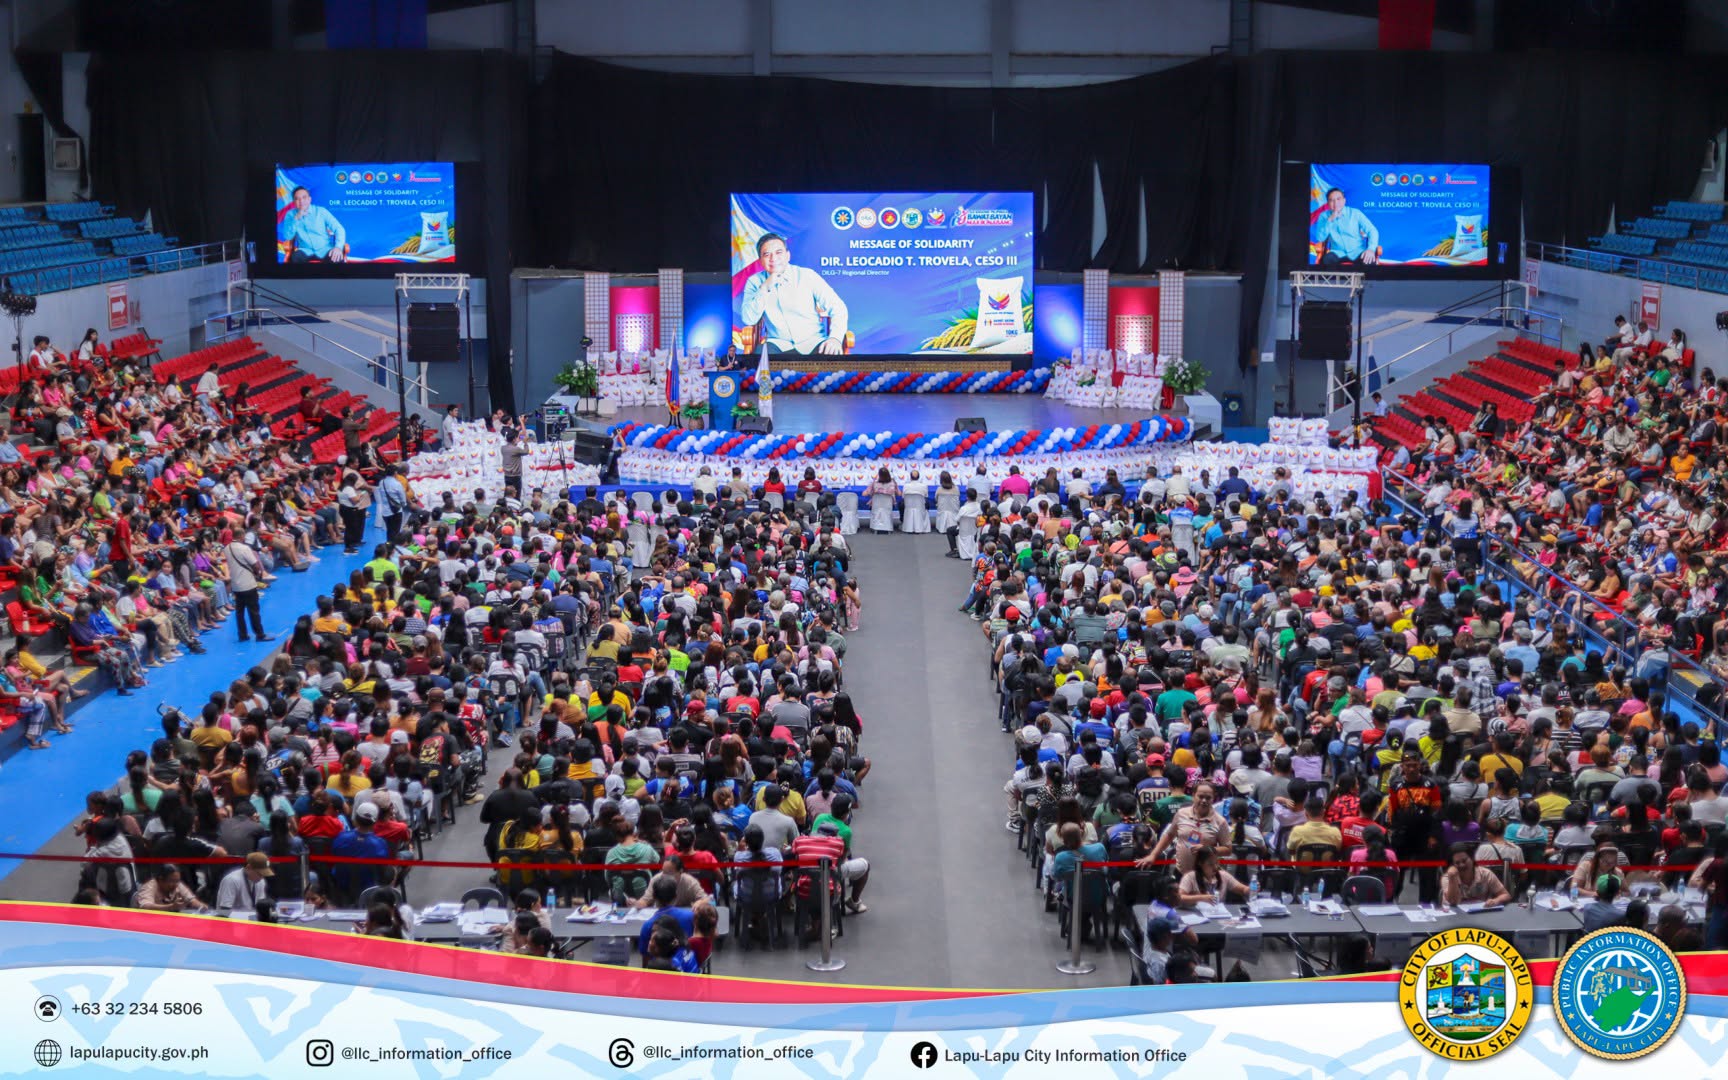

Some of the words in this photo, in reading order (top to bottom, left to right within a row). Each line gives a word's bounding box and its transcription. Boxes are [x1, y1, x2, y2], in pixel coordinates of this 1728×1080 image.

[849, 239, 896, 249] MESSAGE
[898, 239, 912, 249] OF
[914, 239, 974, 249] SOLIDARITY
[820, 256, 843, 267] DIR.
[846, 256, 904, 267] LEOCADIO
[905, 256, 916, 266] T.
[918, 256, 973, 267] TROVELA,
[975, 255, 1004, 266] CESO
[1006, 255, 1018, 266] III
[842, 269, 865, 277] Regional
